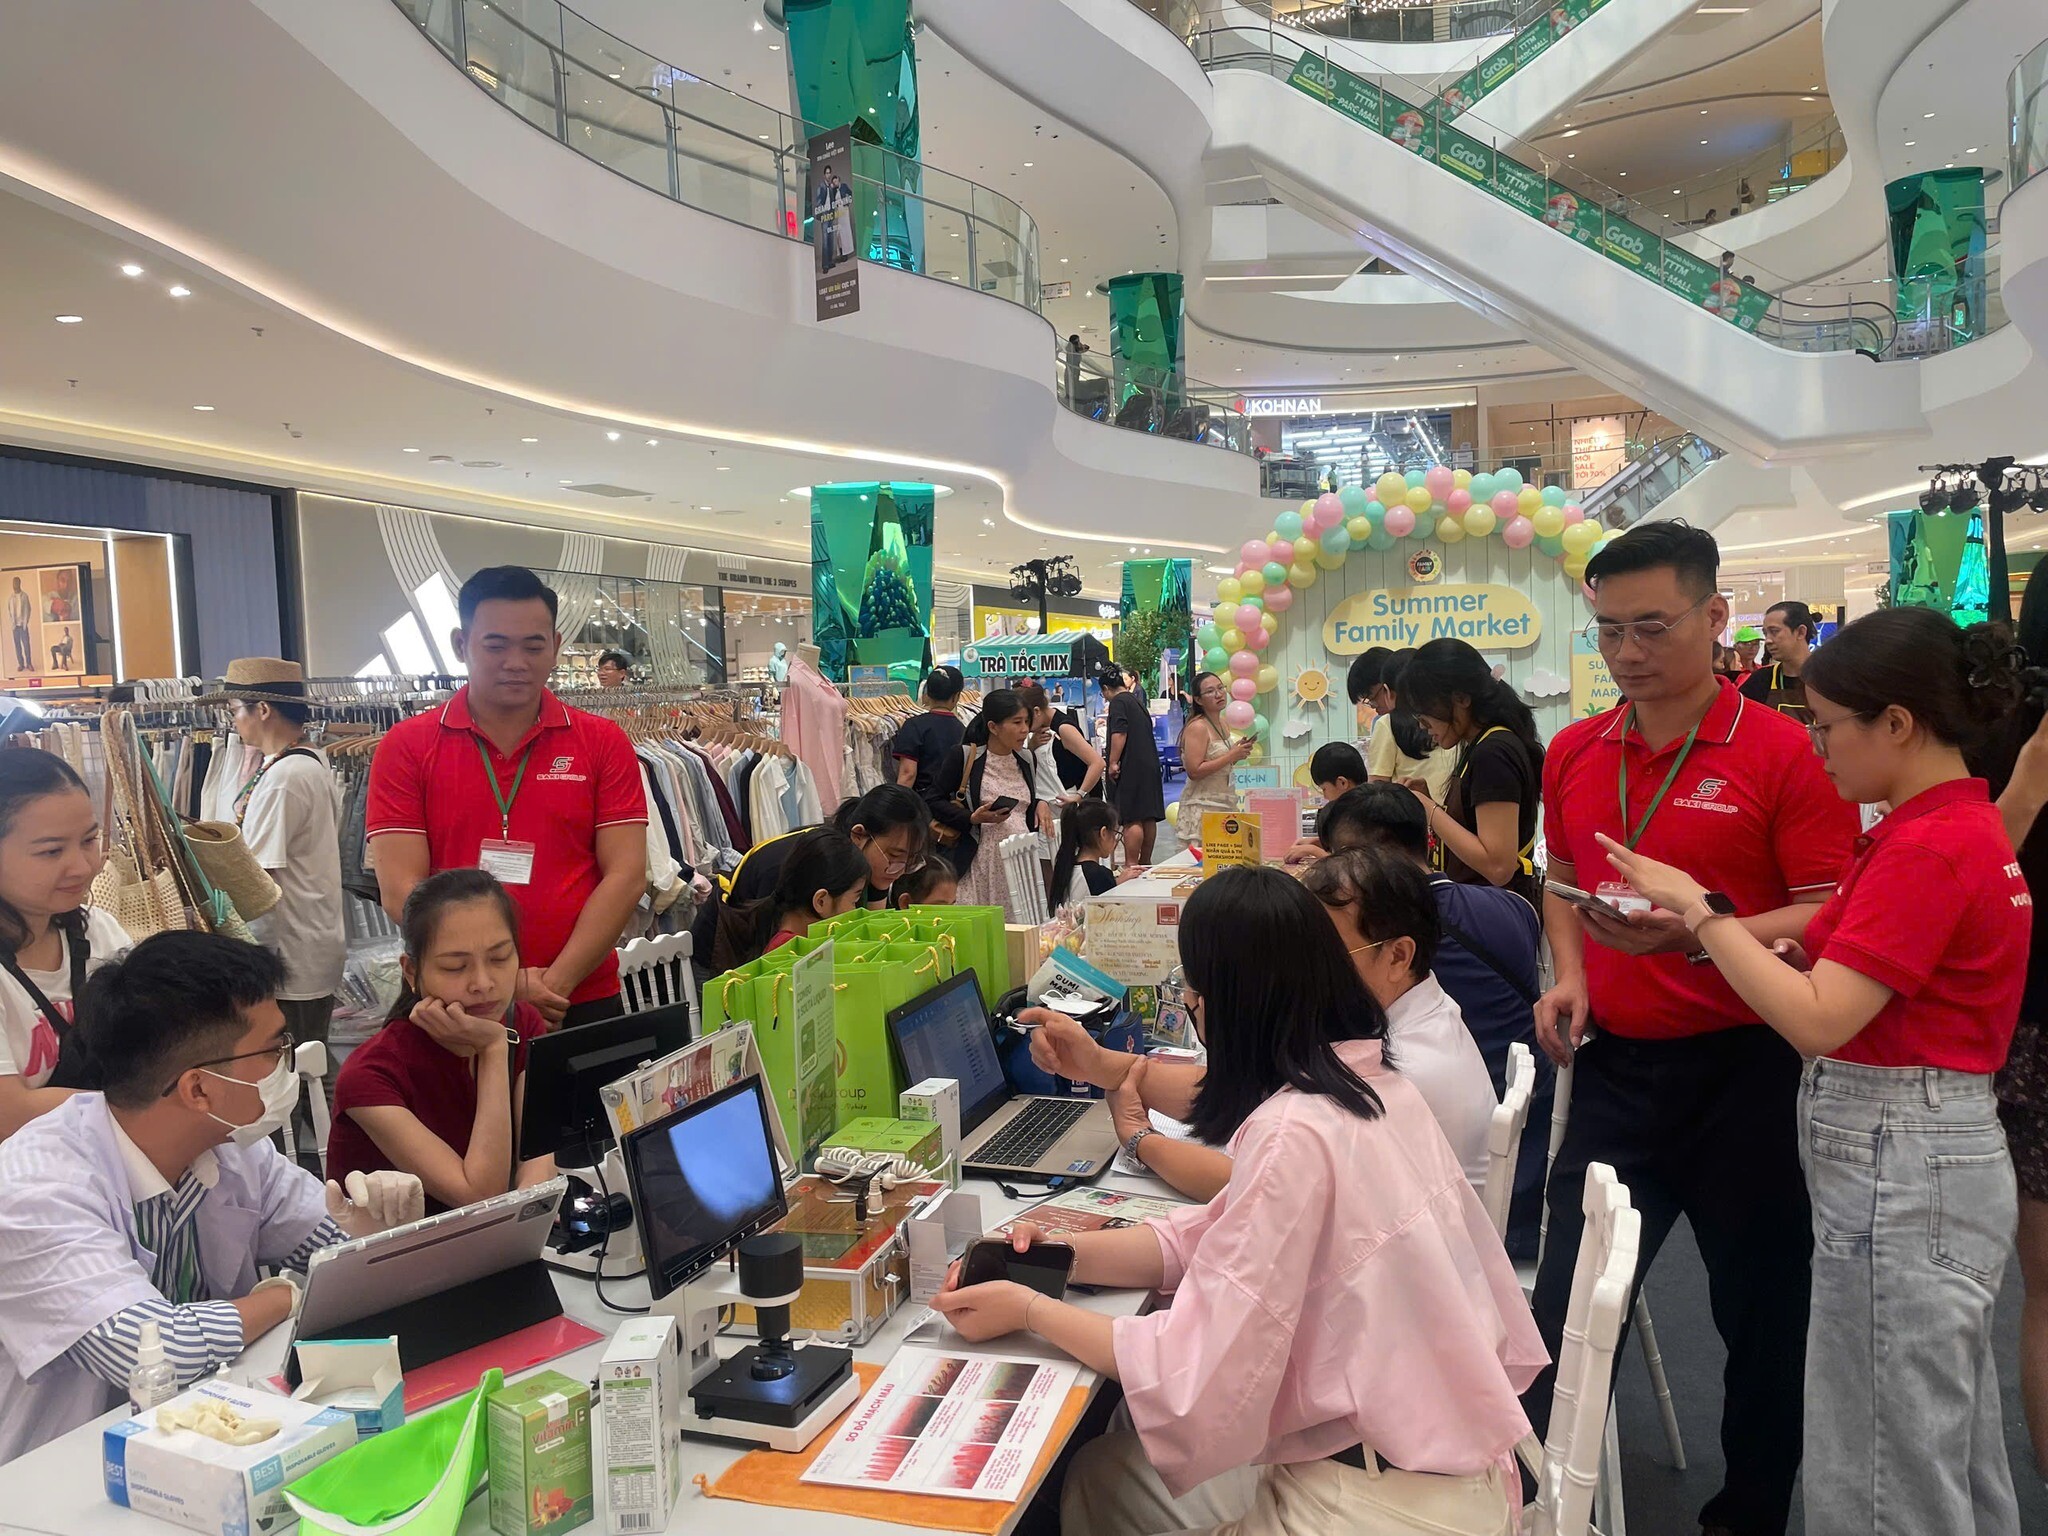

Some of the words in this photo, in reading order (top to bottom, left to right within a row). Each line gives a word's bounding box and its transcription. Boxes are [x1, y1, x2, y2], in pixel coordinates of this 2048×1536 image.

[1302, 63, 1337, 89] Grab
[1481, 57, 1508, 80] Grab
[1338, 97, 1360, 114] PARC
[1354, 92, 1378, 110] TTTM
[1450, 143, 1487, 170] Grab
[1505, 173, 1529, 191] TTTM
[1606, 226, 1644, 254] Grab
[1663, 258, 1689, 276] TTTM
[1251, 398, 1321, 413] KOHNAN
[1575, 462, 1596, 470] SALE
[1590, 470, 1607, 478] 70%
[1373, 593, 1489, 617] Summer
[1335, 617, 1420, 646] Family
[1431, 612, 1531, 639] Market
[979, 652, 1006, 672] TRÀ
[1011, 648, 1037, 672] TẮC
[1040, 654, 1070, 671] MIX
[536, 773, 560, 781] SAKI
[1673, 798, 1701, 809] SAKI
[1701, 801, 1739, 814] GROUP
[1055, 974, 1080, 991] GUMI
[862, 1398, 885, 1420] MẠCH
[878, 1383, 895, 1398] MÁU
[531, 1417, 575, 1446] Vitamin
[575, 1406, 586, 1427] B
[285, 1451, 317, 1472] DISPOSABLE
[316, 1441, 336, 1457] GLOVES
[106, 1460, 124, 1478] BEST
[253, 1460, 279, 1481] BEST
[130, 1482, 163, 1499] DISPOSABLE
[163, 1492, 185, 1506] GLOVES
